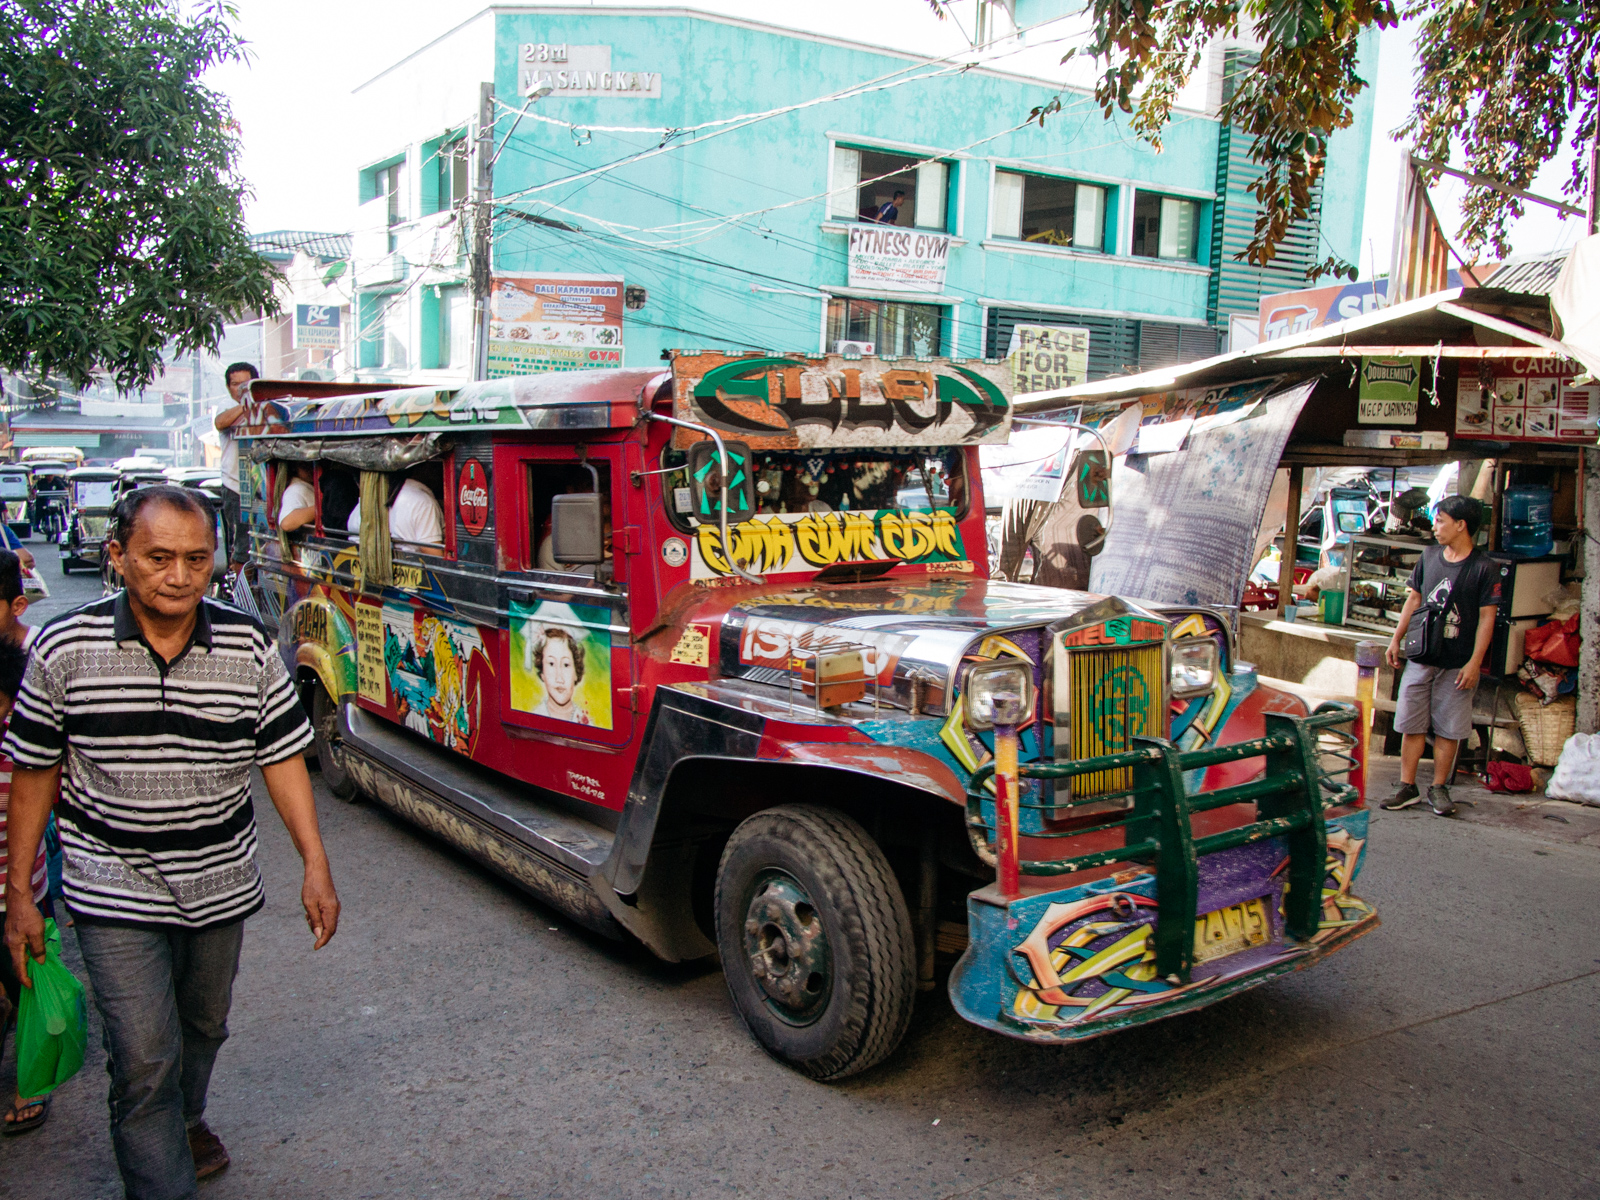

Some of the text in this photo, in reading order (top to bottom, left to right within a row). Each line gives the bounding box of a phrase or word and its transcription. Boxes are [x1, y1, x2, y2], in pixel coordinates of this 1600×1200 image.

[525, 43, 568, 62] 23rd
[525, 70, 655, 92] MASANGKAY
[850, 228, 950, 259] FITNESS GYM
[535, 285, 617, 295] BALE KAPAMPANGAN
[306, 305, 330, 324] RC
[1020, 329, 1086, 352] PACE
[489, 344, 501, 352] EN
[513, 346, 547, 356] WOMEN
[550, 348, 584, 358] FITNESS
[588, 350, 620, 361] GYM
[1019, 352, 1068, 373] FOR
[1367, 365, 1413, 382] DOUBLEMINT
[1065, 623, 1116, 647] MEL
